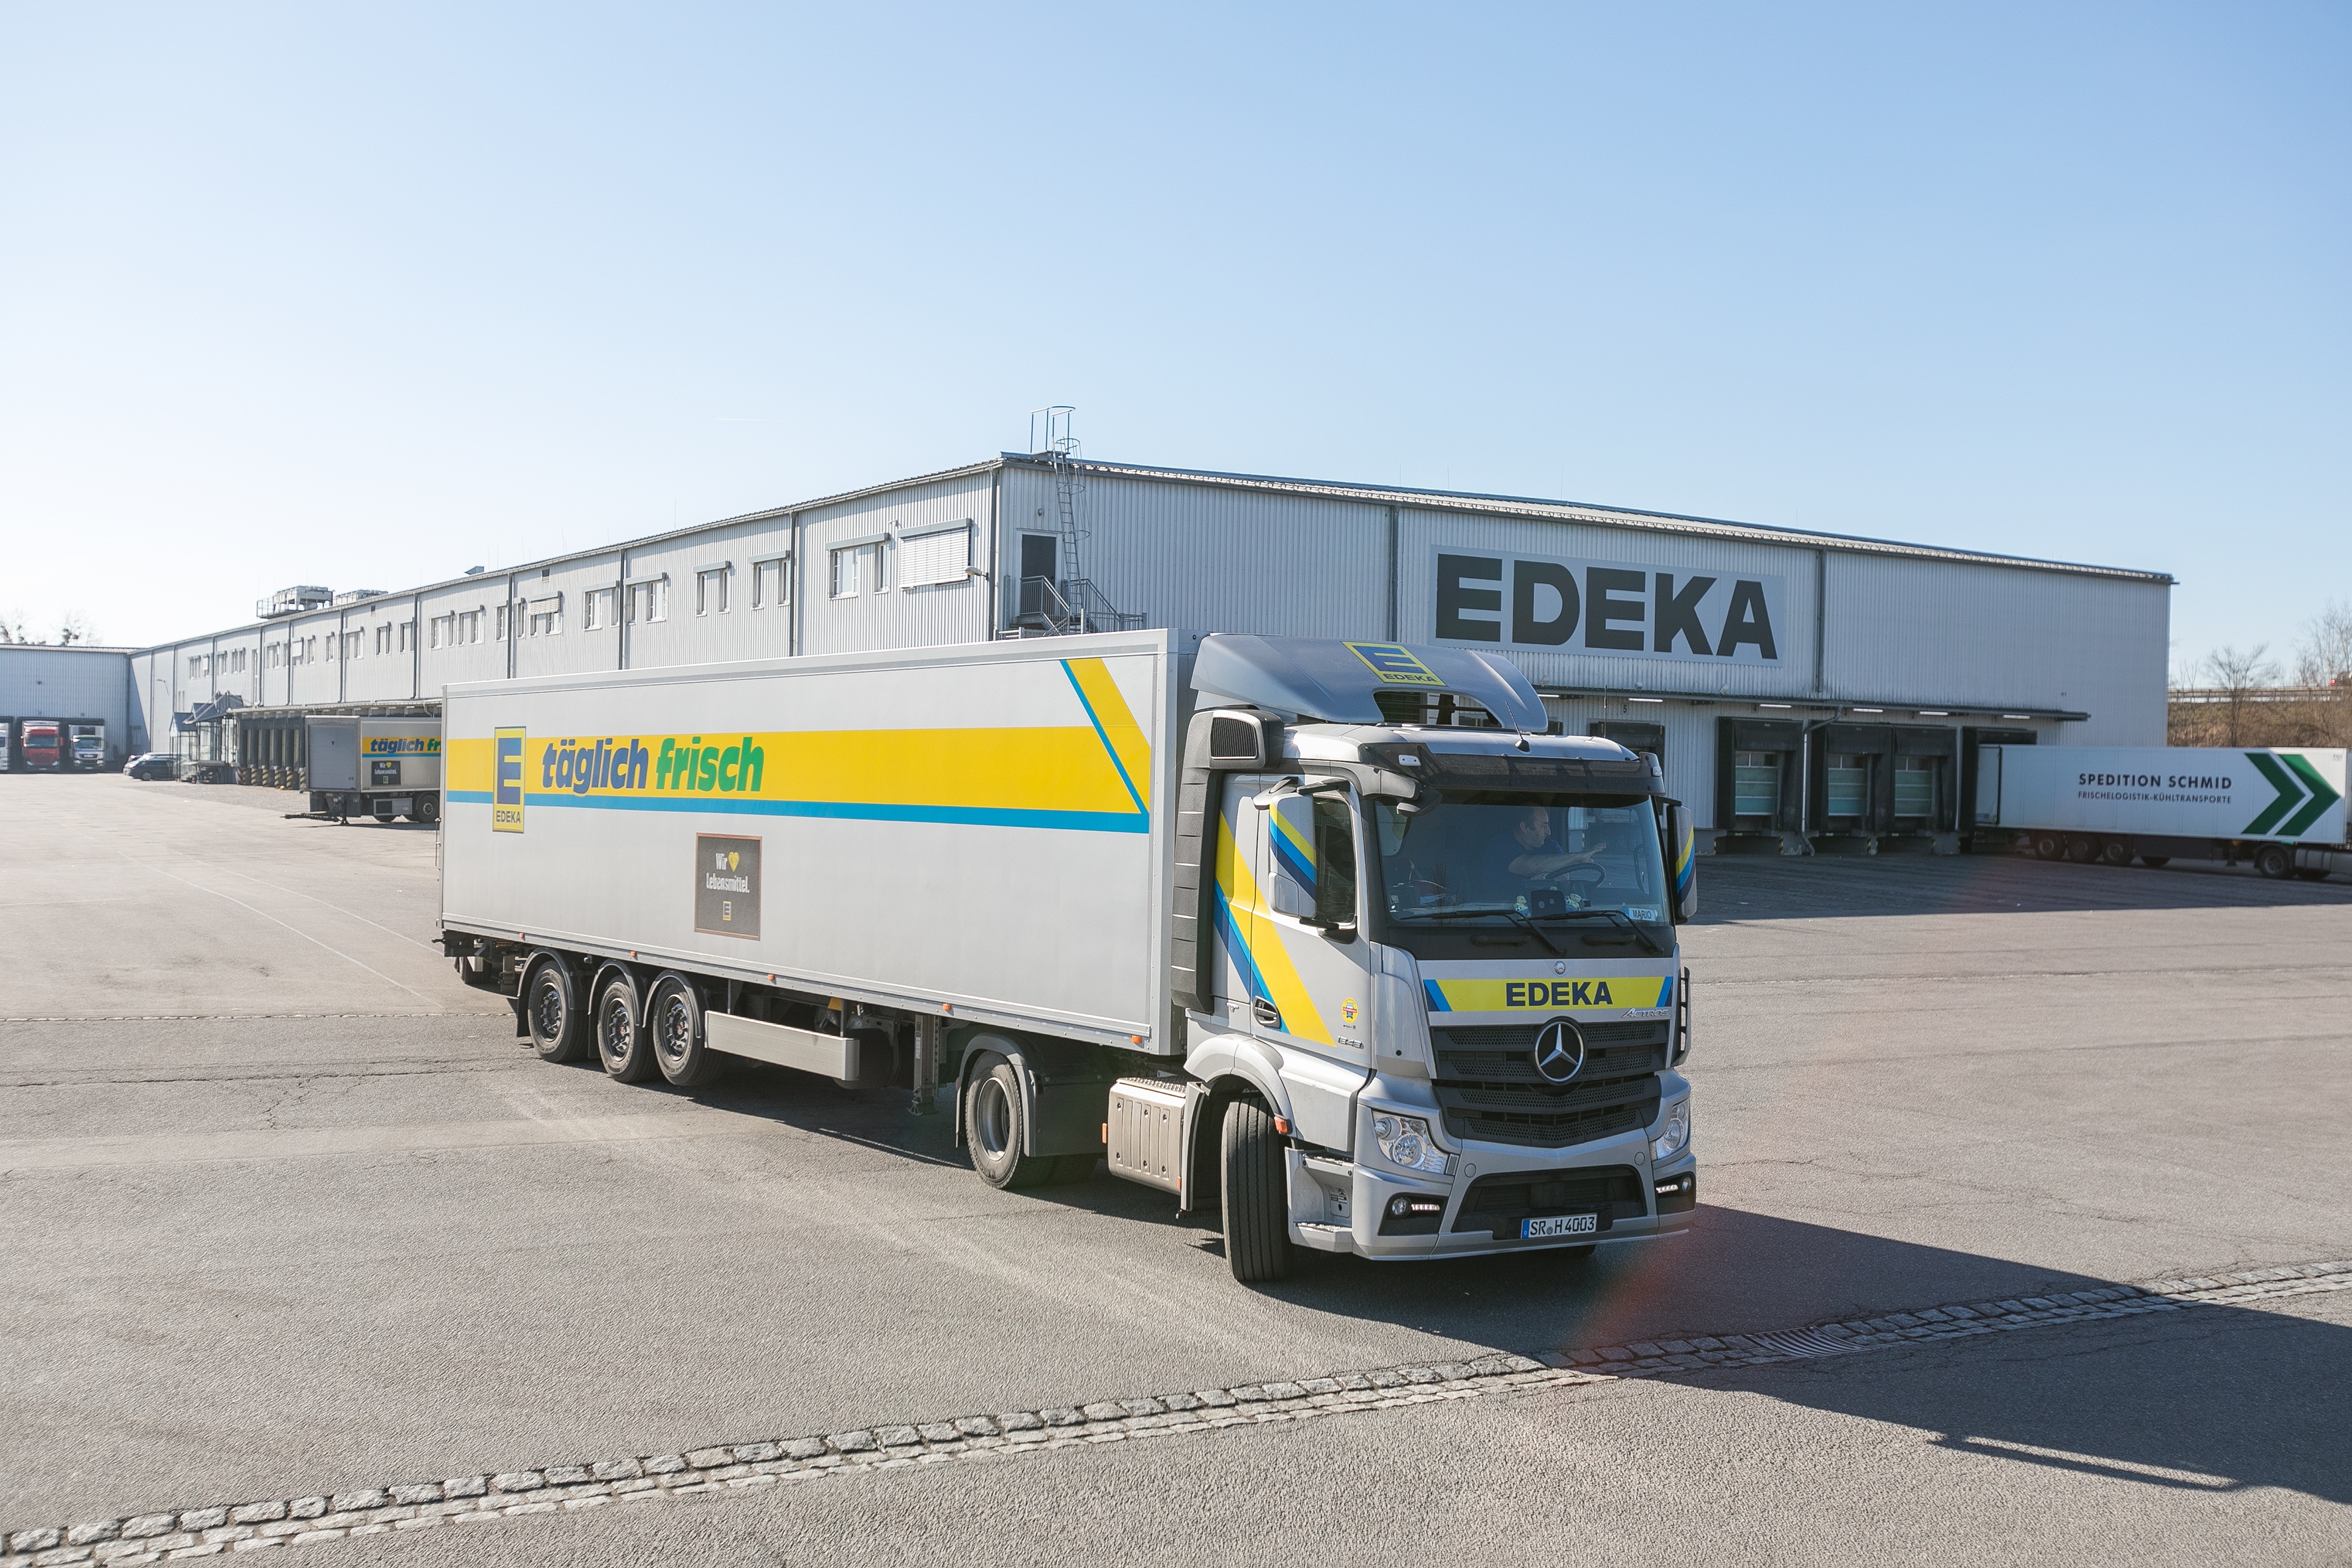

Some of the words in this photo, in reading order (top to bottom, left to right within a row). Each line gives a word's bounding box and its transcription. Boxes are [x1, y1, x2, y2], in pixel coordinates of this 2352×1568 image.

[1435, 553, 1778, 659] EDEKA
[1352, 645, 1427, 674] E
[1382, 674, 1437, 682] EDEKA
[1623, 704, 1627, 714] 5
[370, 738, 424, 753] täglich
[497, 738, 522, 805] E
[542, 738, 649, 795] täglich
[656, 736, 764, 792] frisch
[2079, 773, 2161, 787] SPEDITION
[2168, 775, 2232, 789] SCHMID
[496, 811, 520, 823] EDEKA
[716, 853, 728, 870] Wir
[706, 872, 750, 893] Lebensmittel.
[1632, 909, 1652, 919] MARIO
[1506, 980, 1613, 1006] EDEKA
[1530, 1221, 1546, 1235] SR
[1554, 1219, 1563, 1233] H
[1565, 1217, 1595, 1232] 4003
